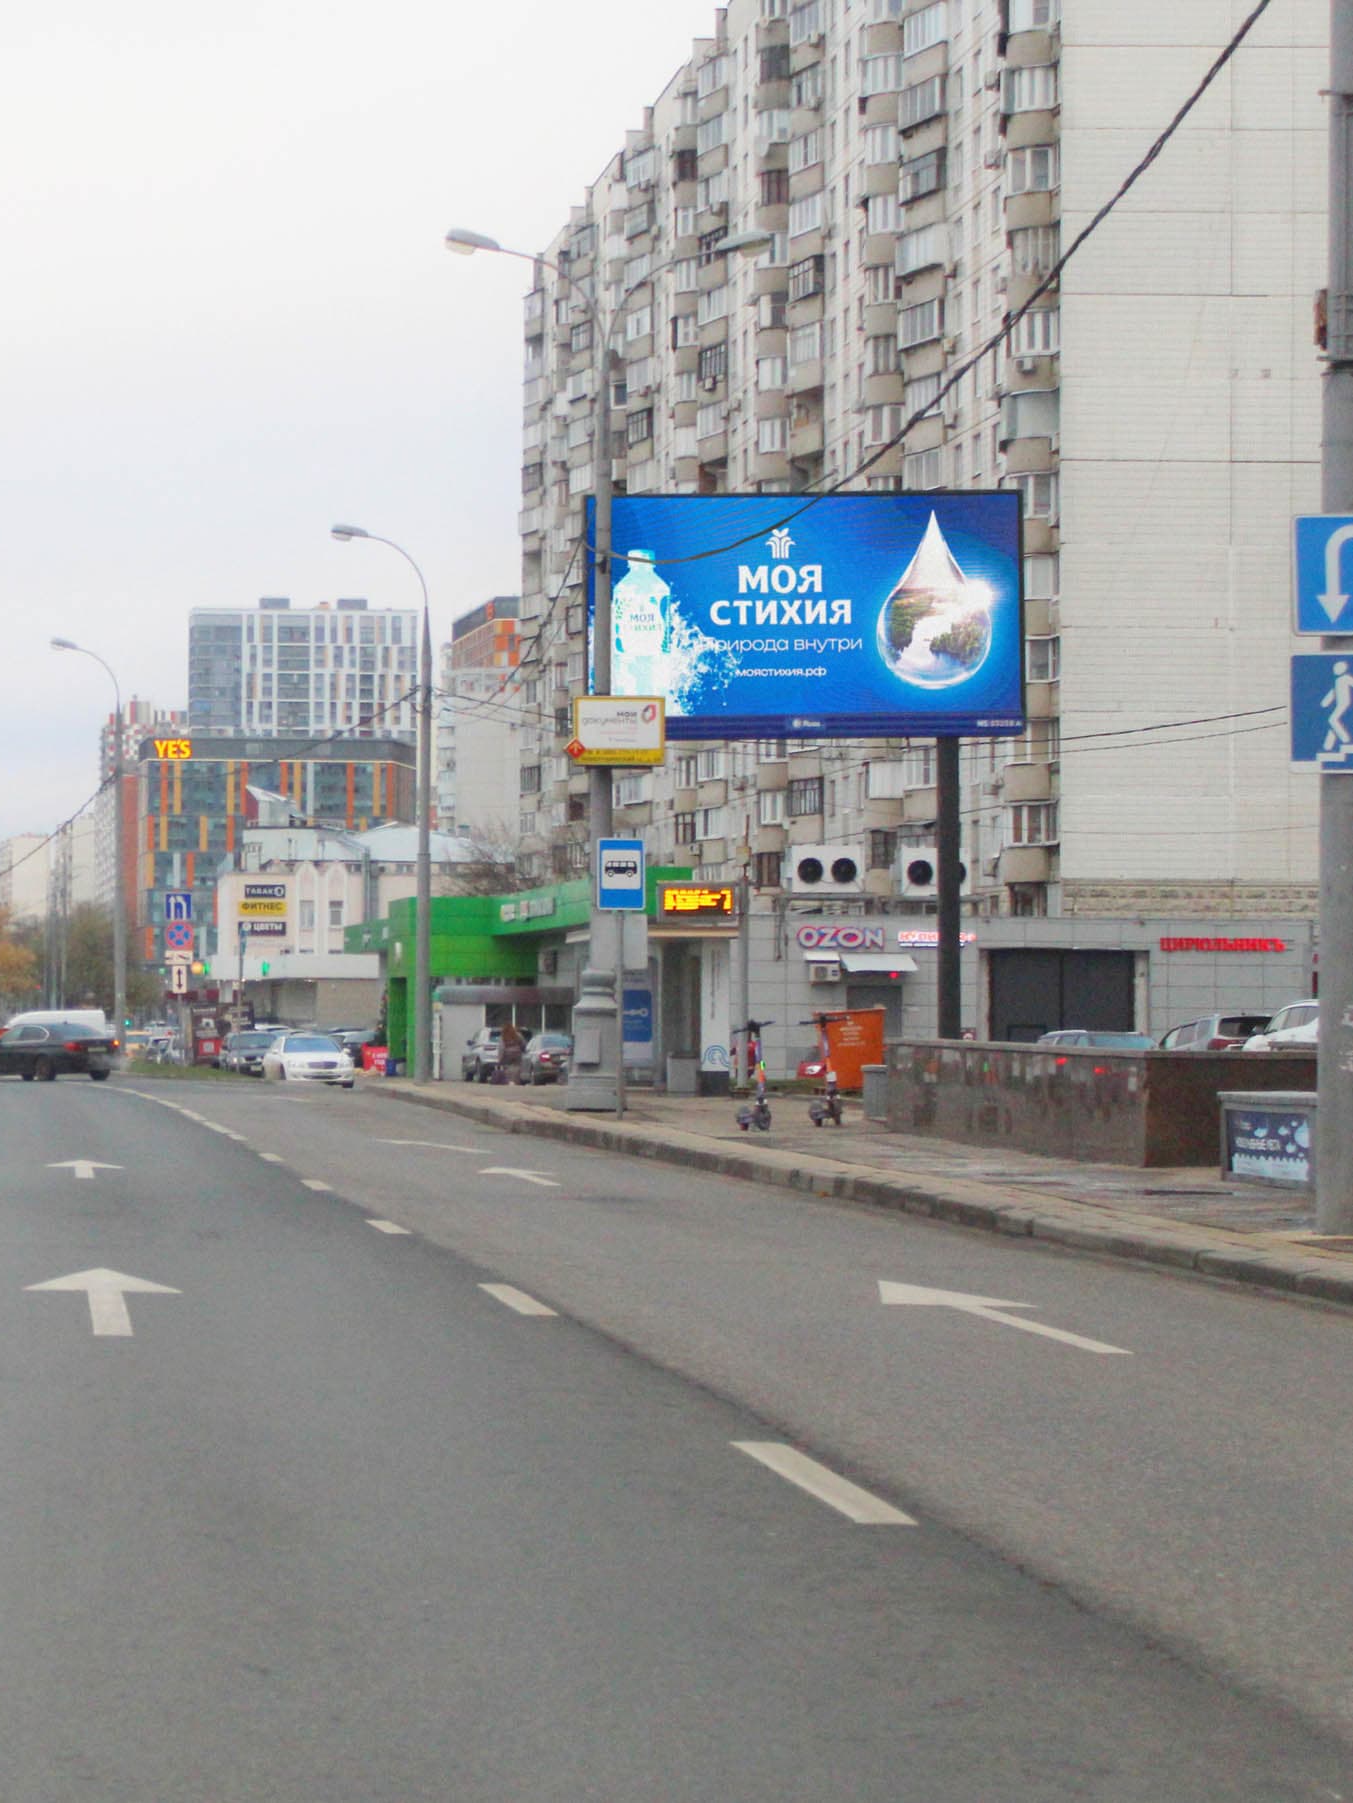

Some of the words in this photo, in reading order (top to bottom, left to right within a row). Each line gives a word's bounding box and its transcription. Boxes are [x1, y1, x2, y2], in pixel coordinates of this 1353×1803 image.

[738, 565, 823, 593] МОЯ
[710, 599, 852, 625] СТИХИЯ
[794, 637, 863, 653] внутри
[242, 902, 283, 911] ФИТНЕС
[253, 922, 283, 931] ЦВЕТЫ
[798, 926, 883, 949] OZON
